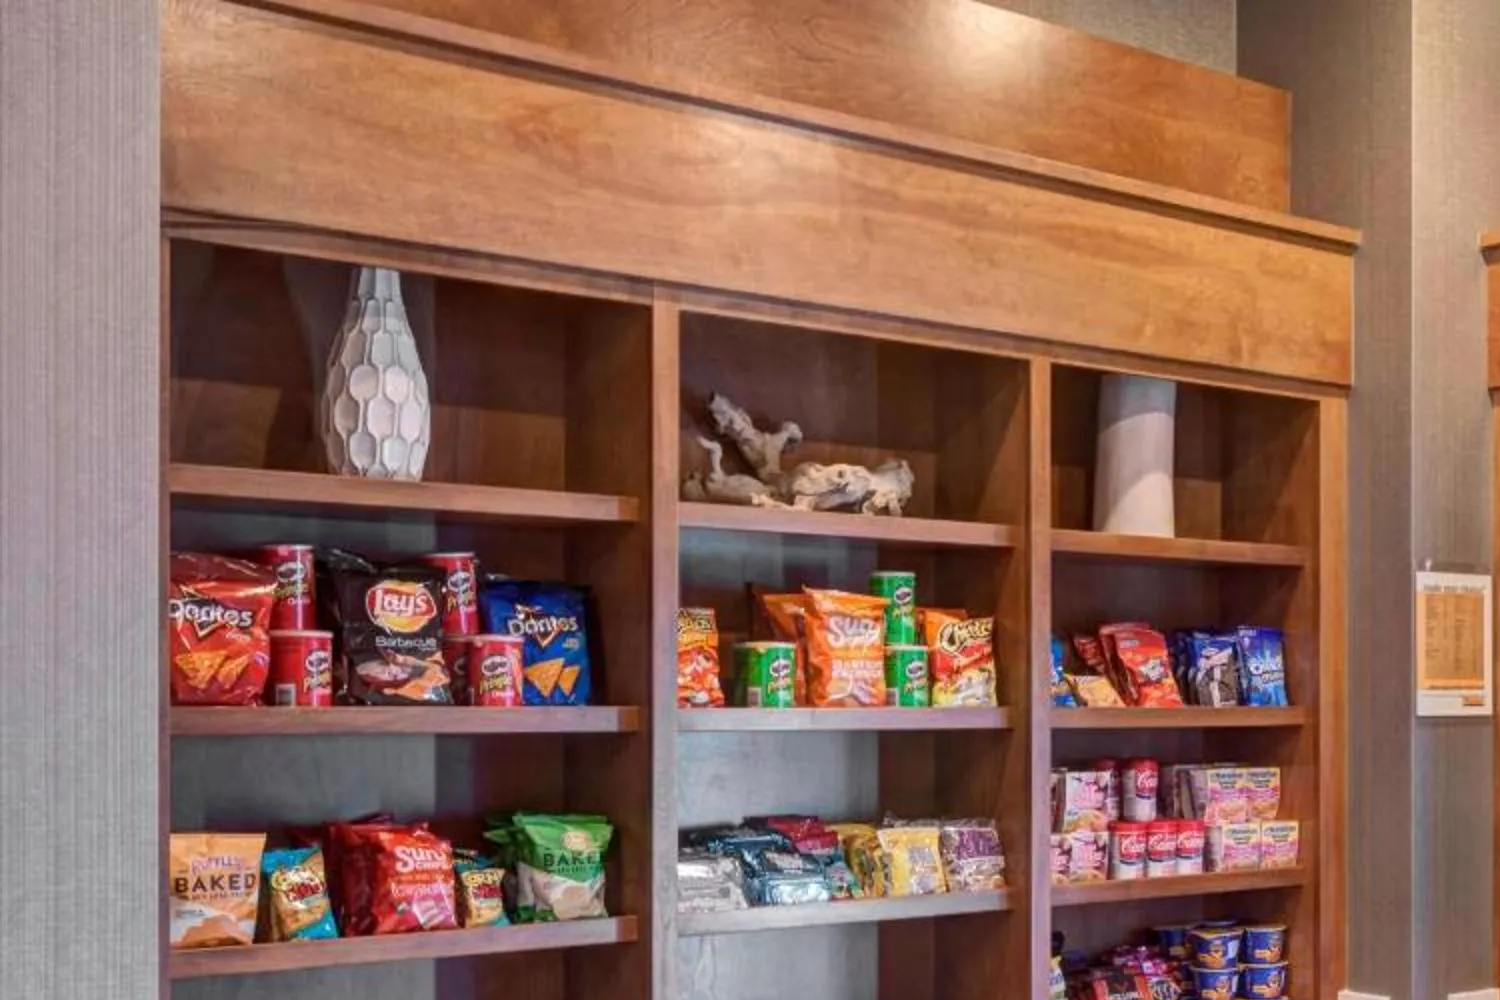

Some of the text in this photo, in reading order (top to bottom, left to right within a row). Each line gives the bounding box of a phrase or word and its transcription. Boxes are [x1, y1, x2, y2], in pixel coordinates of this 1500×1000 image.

[168, 599, 254, 629] Doritos
[508, 613, 579, 639] Doritos
[375, 635, 437, 651] Barbecue
[174, 873, 257, 897] BAKED
